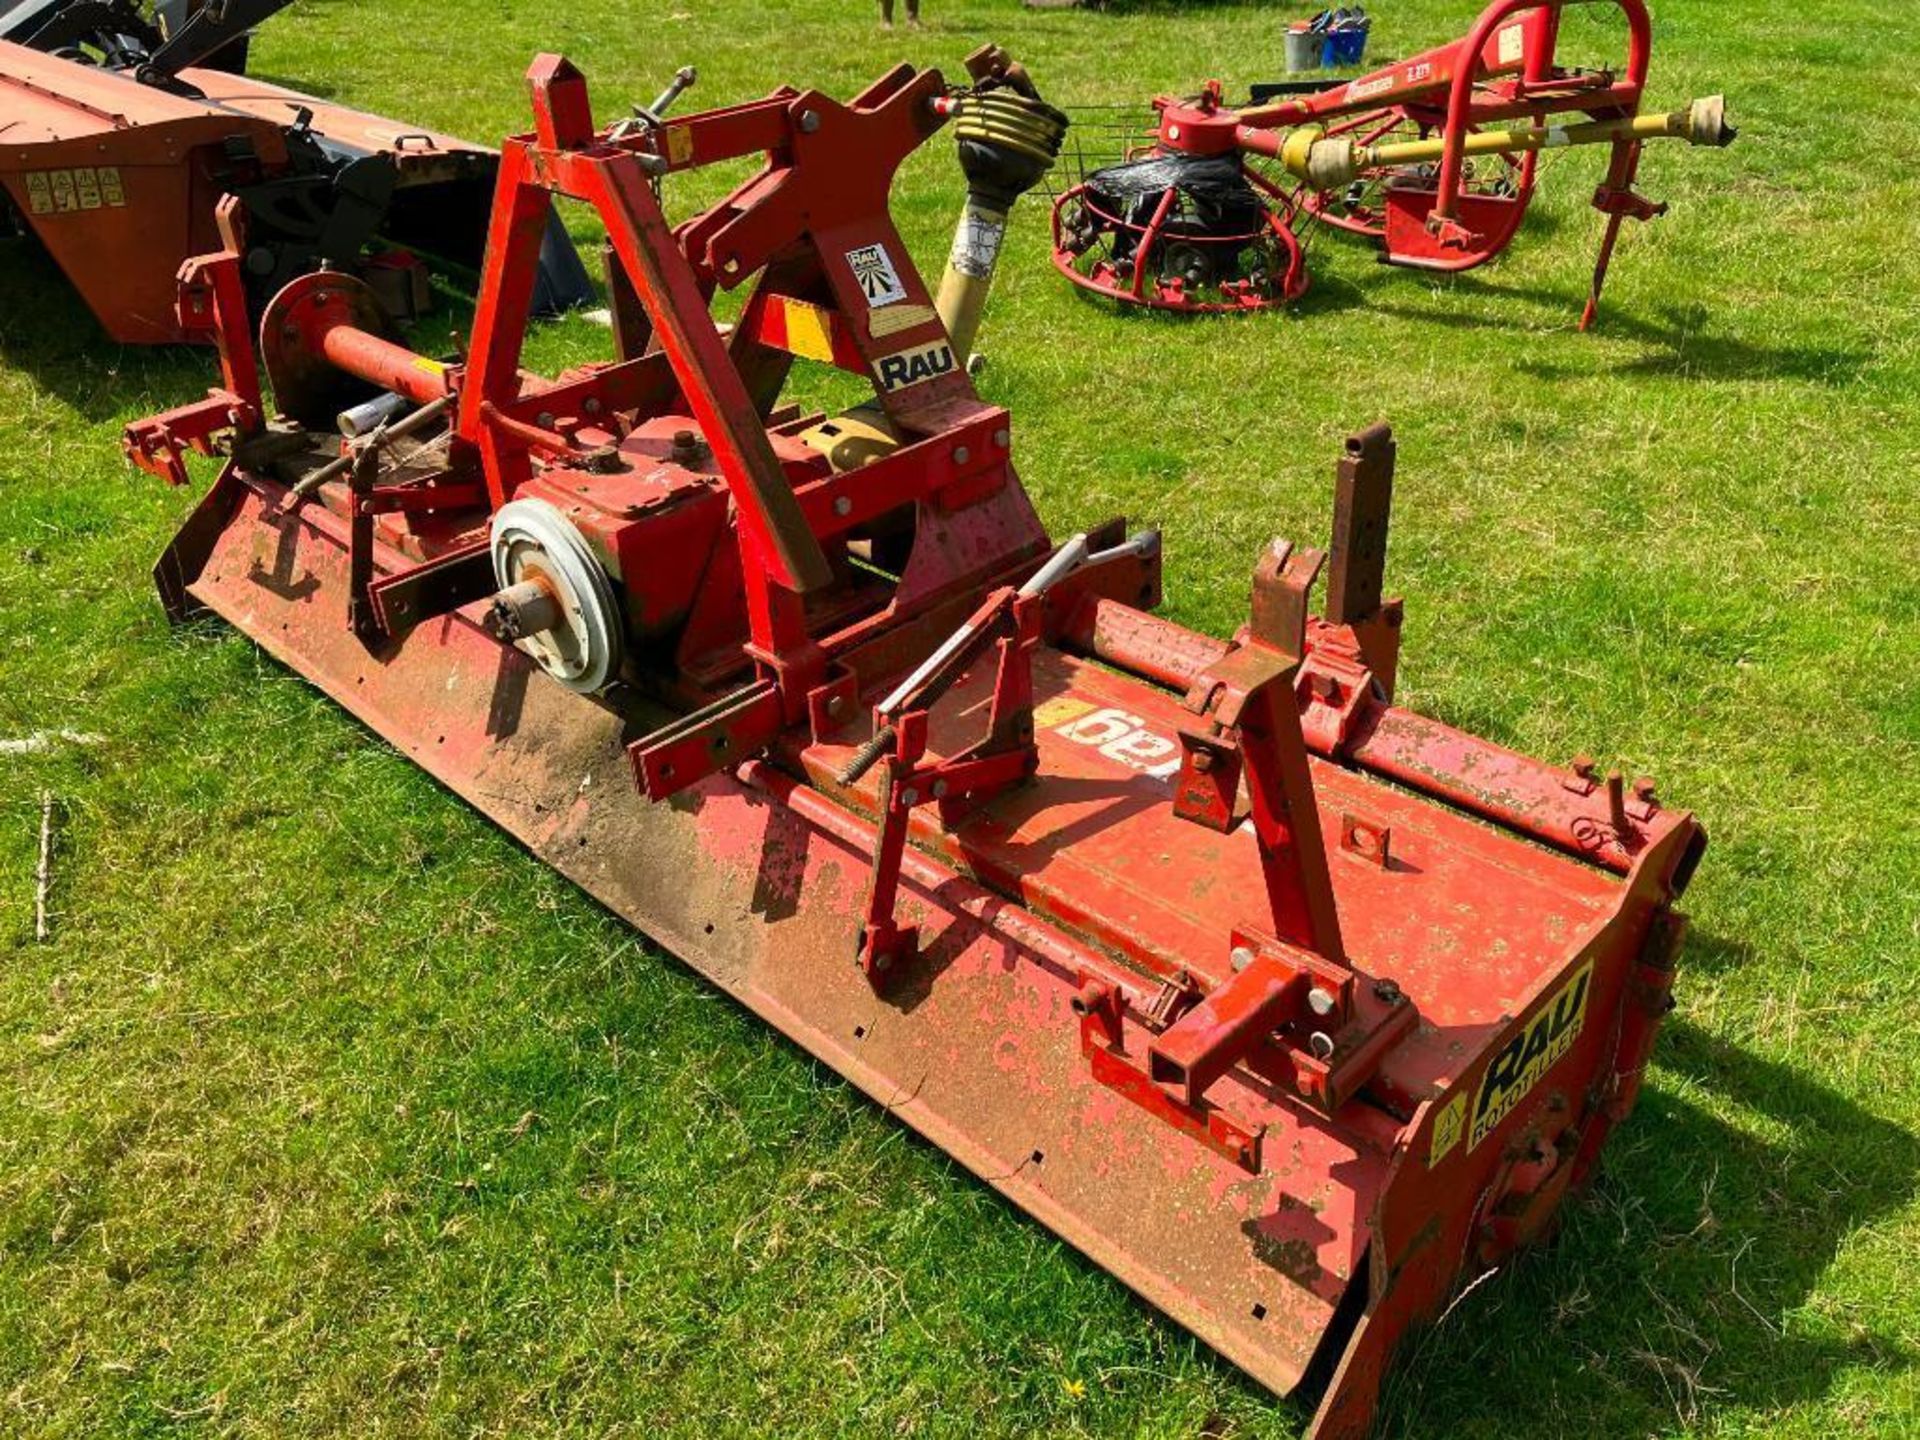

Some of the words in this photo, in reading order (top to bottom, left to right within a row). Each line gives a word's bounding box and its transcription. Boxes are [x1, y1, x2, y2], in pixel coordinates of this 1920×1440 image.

[851, 248, 878, 264] RAU
[880, 346, 952, 389] RAU
[1472, 1019, 1582, 1146] ROTOTILLER
[1476, 970, 1590, 1121] RAU
